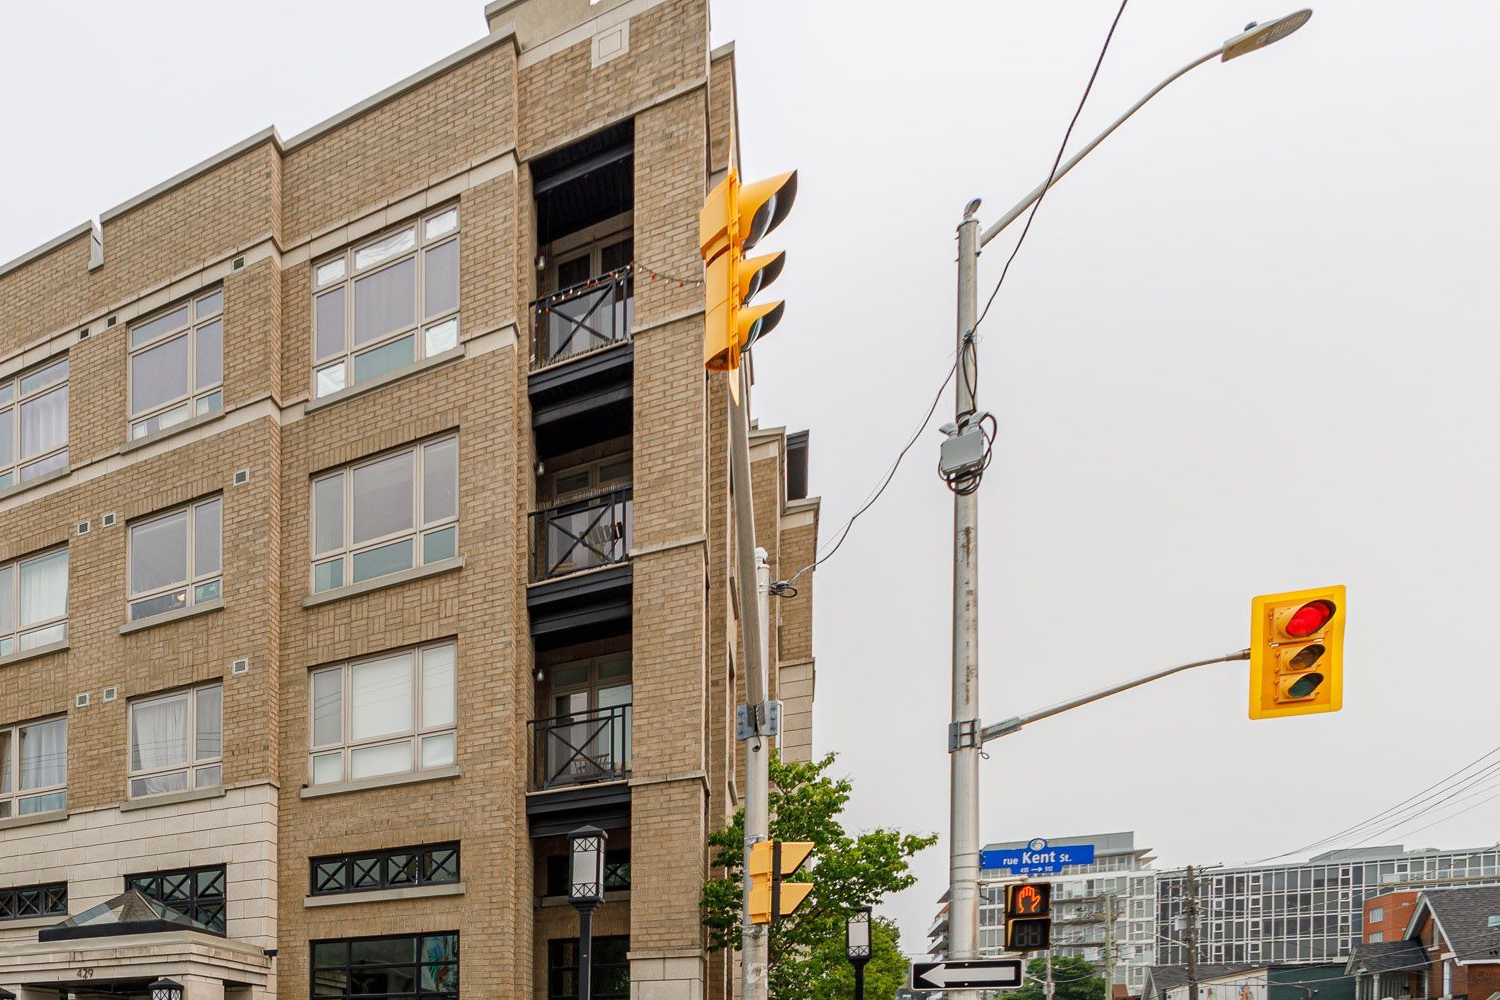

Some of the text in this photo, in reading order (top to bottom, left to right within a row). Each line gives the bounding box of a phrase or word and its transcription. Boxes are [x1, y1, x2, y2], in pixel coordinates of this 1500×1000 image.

[1002, 857, 1019, 866] rue
[1022, 851, 1056, 864] Kent
[76, 968, 93, 979] 429
